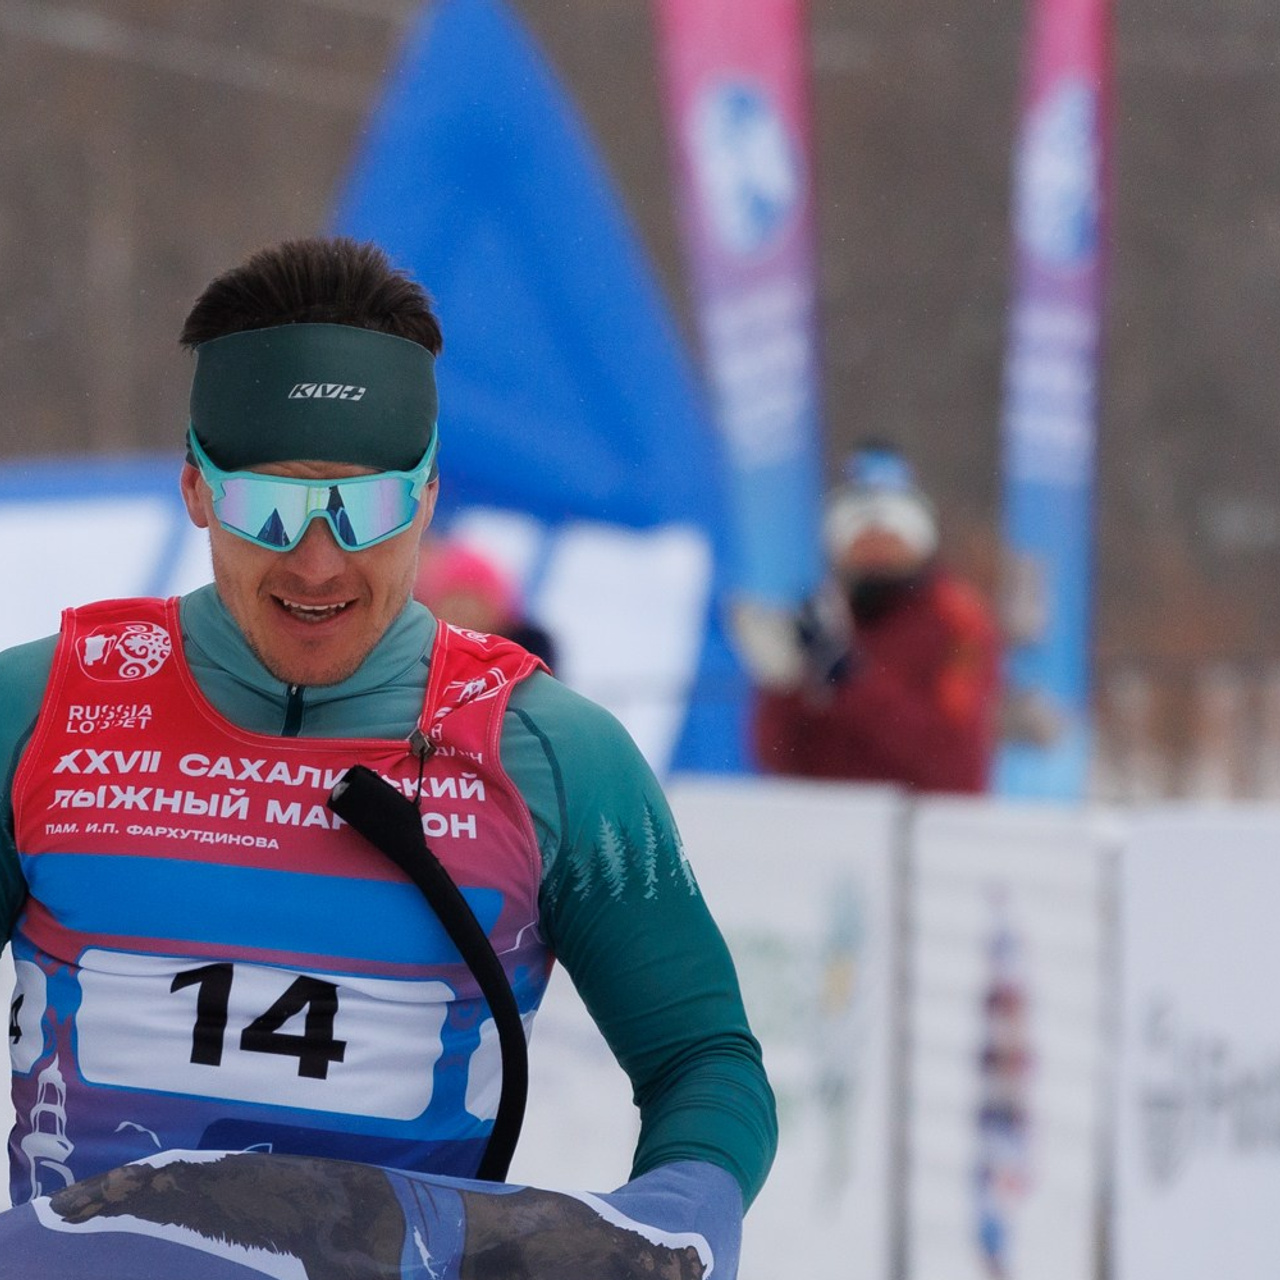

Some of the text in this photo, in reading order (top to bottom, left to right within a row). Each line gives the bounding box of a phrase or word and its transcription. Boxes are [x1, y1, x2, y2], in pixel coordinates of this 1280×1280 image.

[288, 382, 367, 401] KV+
[52, 749, 162, 775] XXVII
[178, 753, 486, 801] САХАЛИКИЙ
[46, 785, 250, 820] ЛЫЖНЫЙ
[45, 823, 279, 849] ПАМ. И.П. ФАРХУТДИНОВА
[170, 963, 346, 1080] 14
